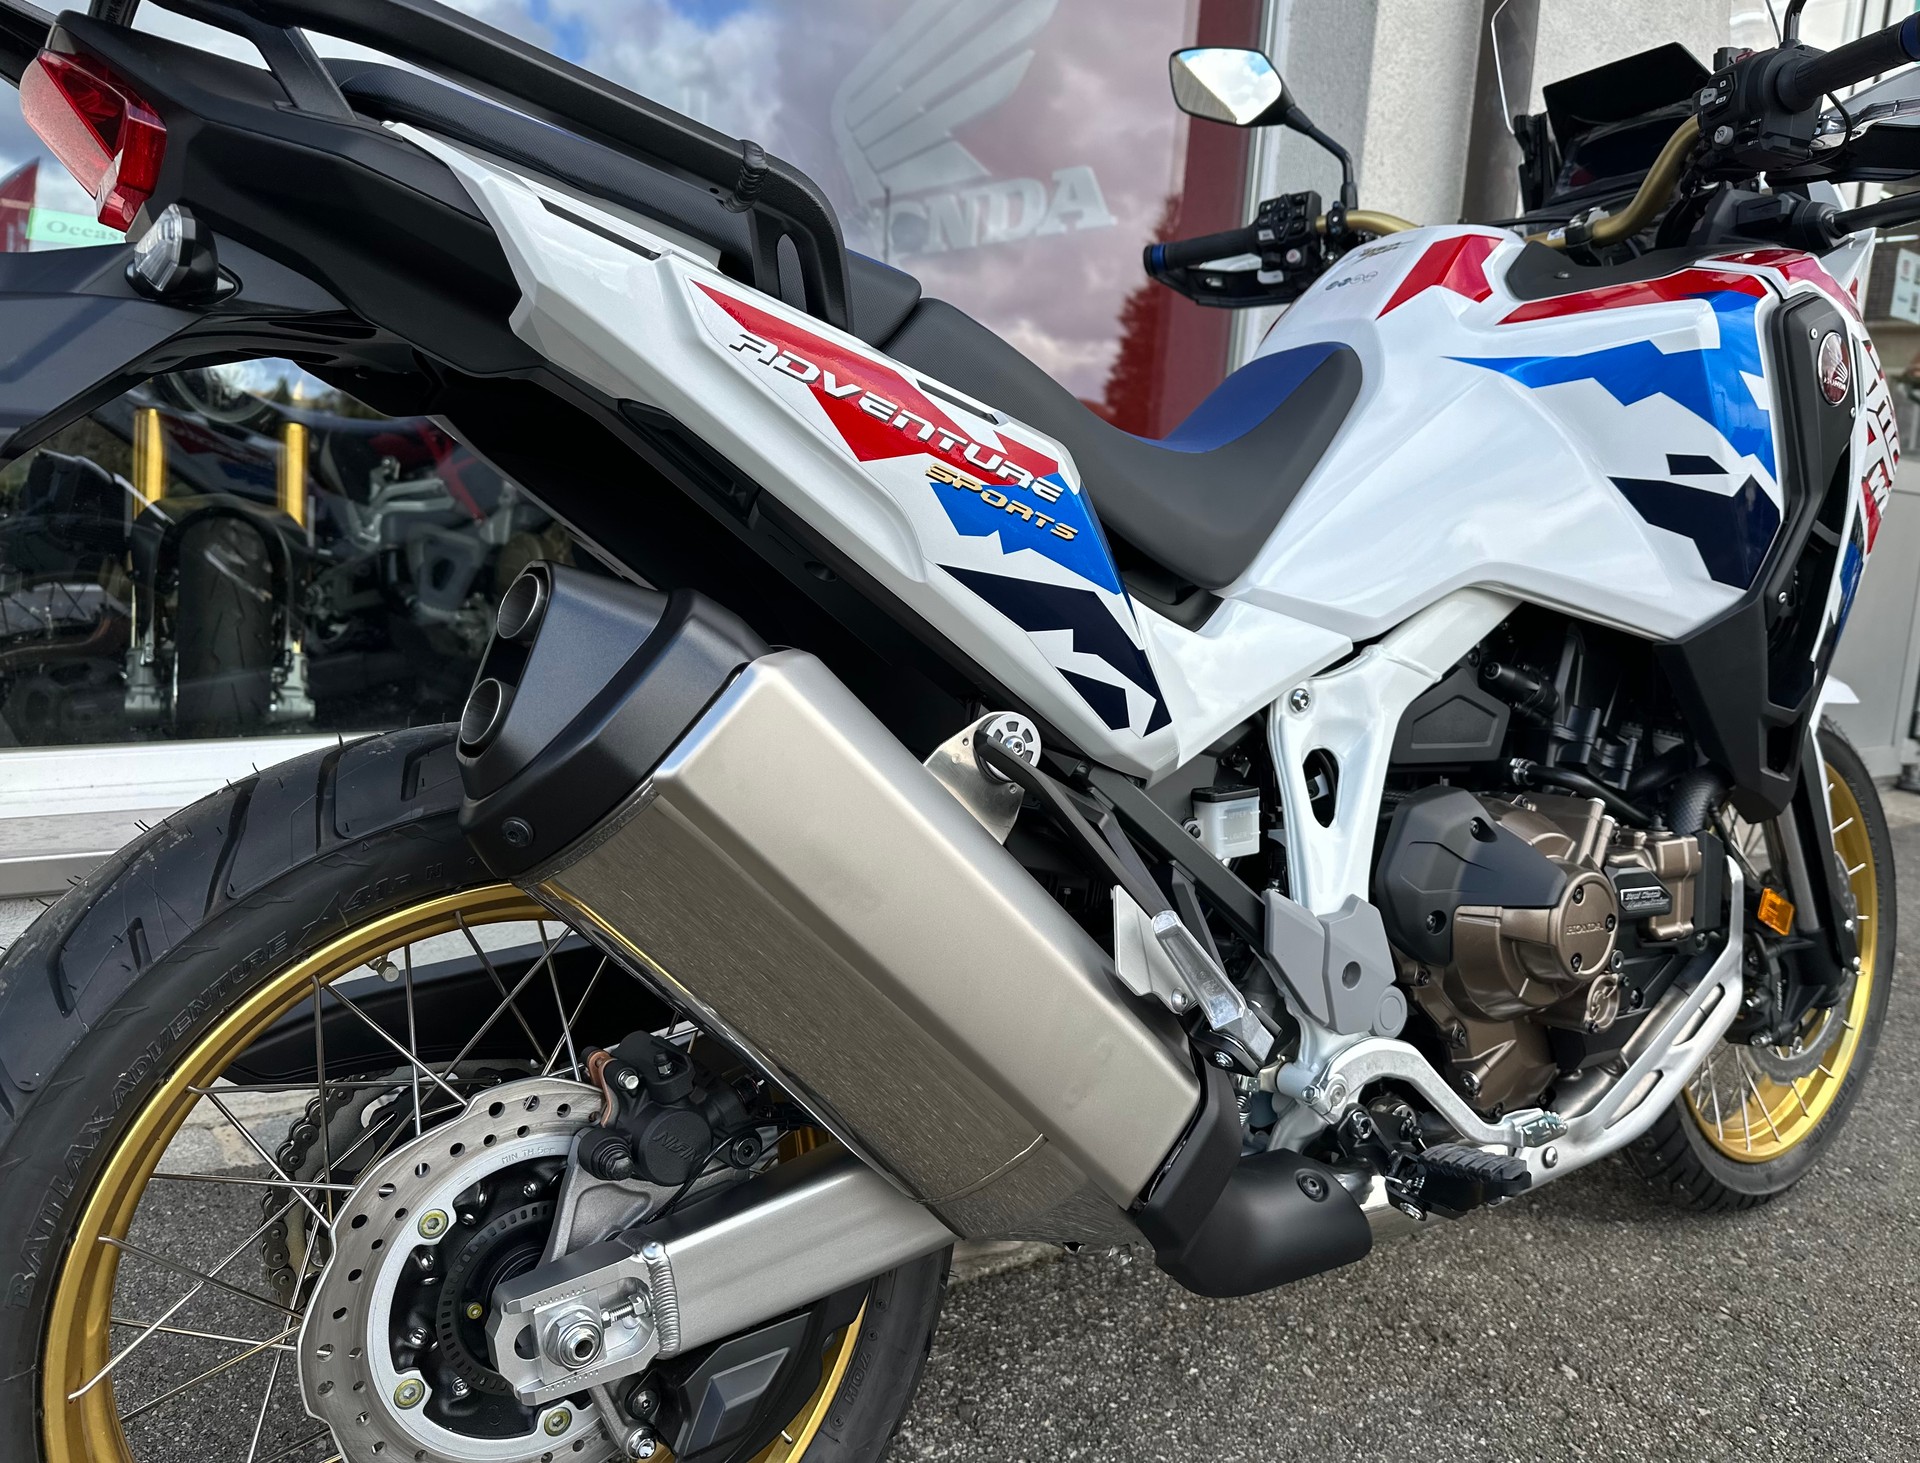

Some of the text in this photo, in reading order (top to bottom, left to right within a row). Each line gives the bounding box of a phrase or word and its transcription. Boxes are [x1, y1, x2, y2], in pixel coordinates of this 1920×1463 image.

[729, 334, 1065, 503] ADVENTURE
[925, 463, 1079, 541] SPORTS
[1566, 922, 1604, 936] HONDA
[111, 930, 288, 1110] ADVENTURE
[502, 1152, 519, 1165] MIN
